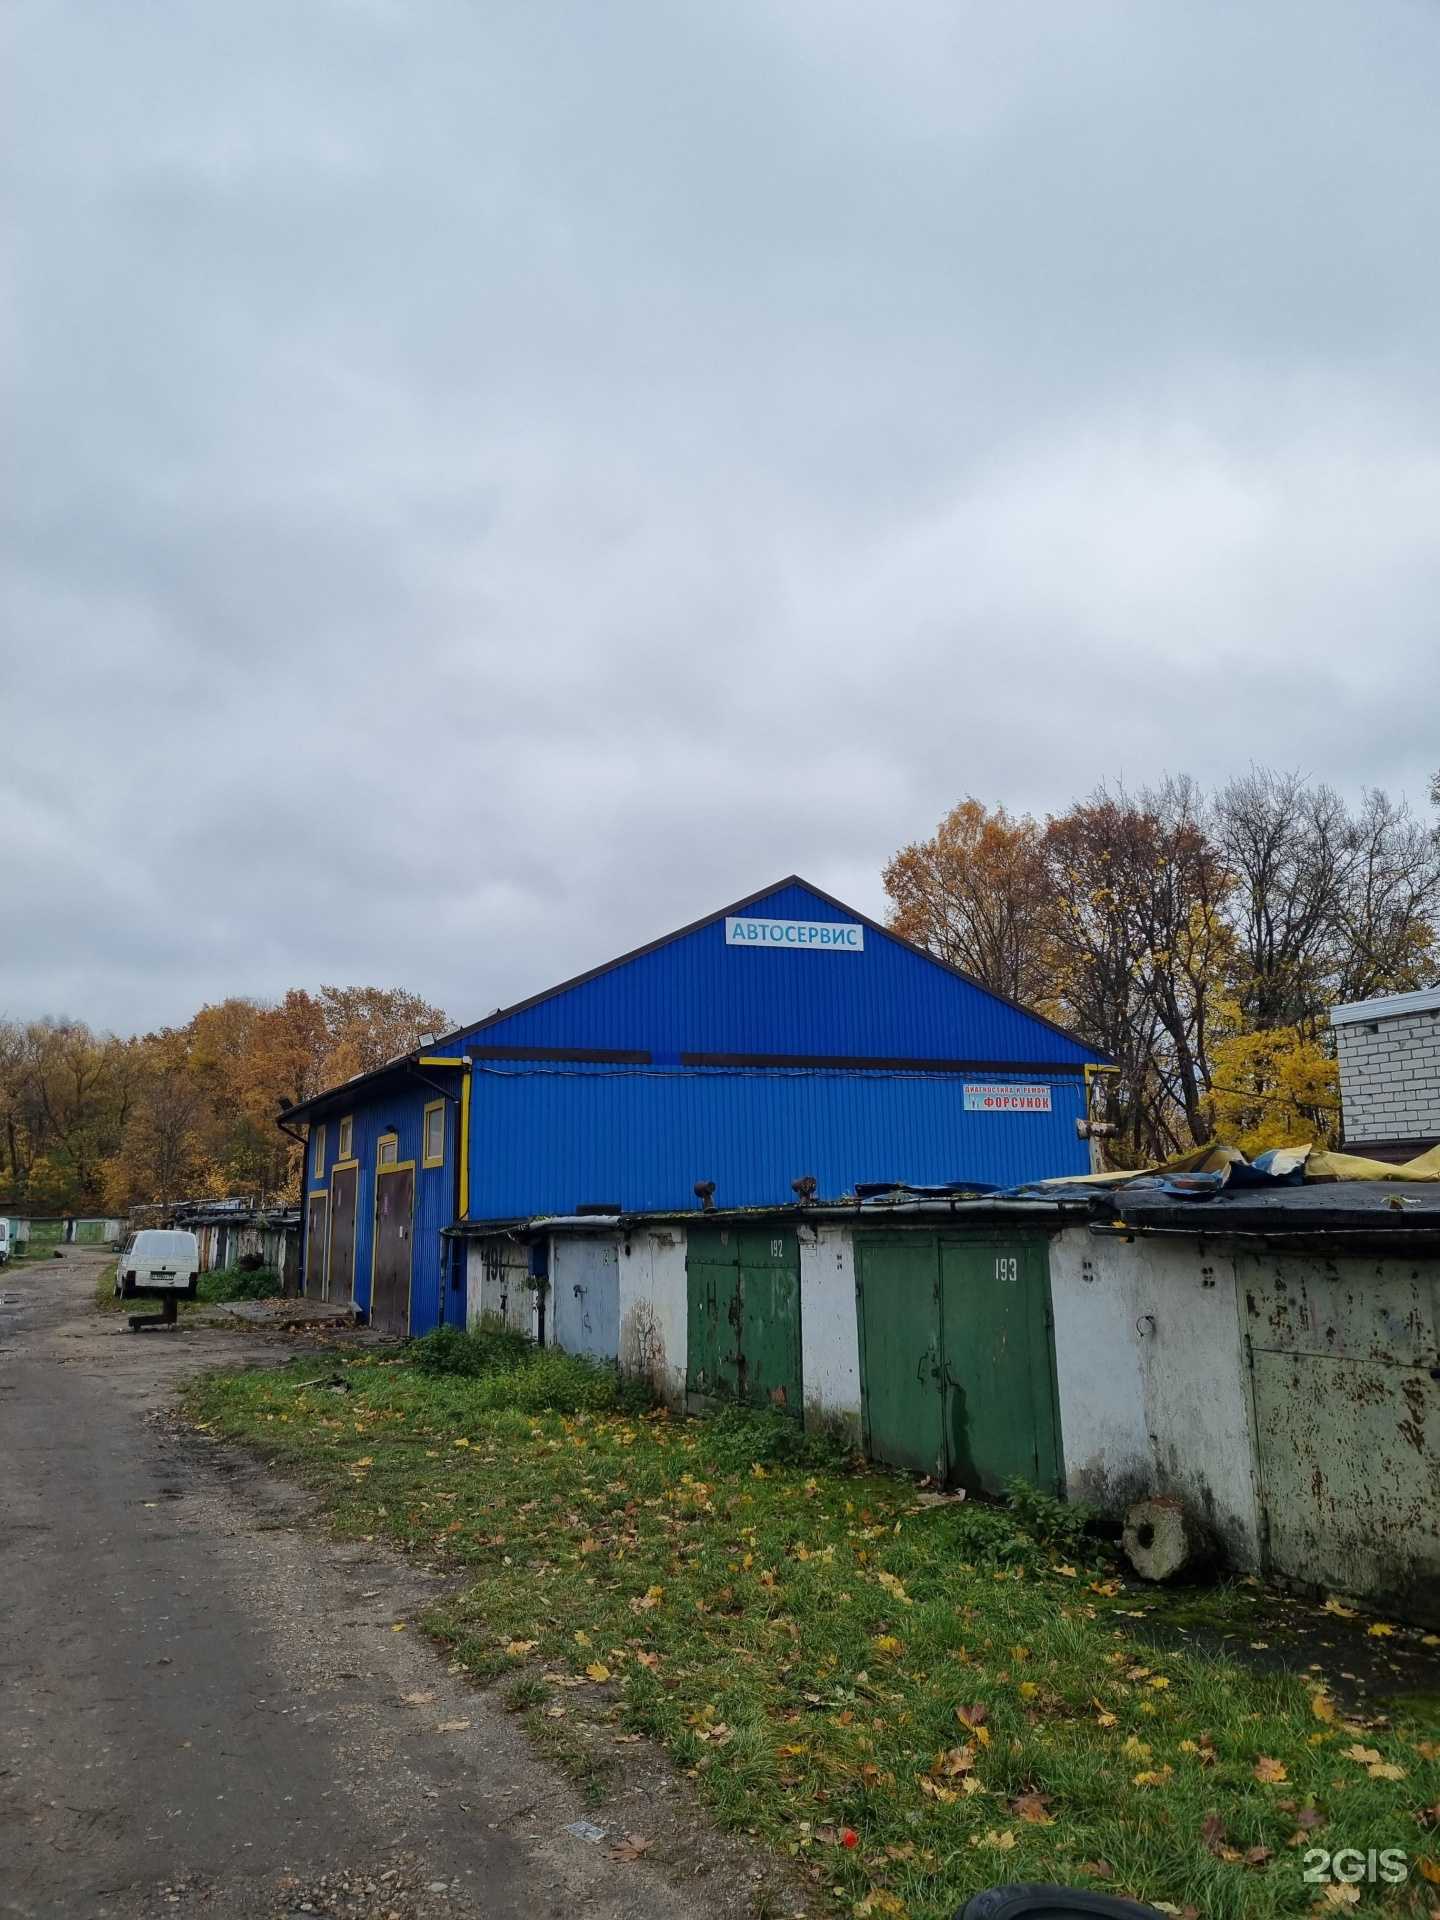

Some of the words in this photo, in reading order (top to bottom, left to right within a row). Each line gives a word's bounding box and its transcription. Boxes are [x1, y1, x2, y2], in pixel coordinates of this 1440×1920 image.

[732, 922, 857, 946] АВТОСЕРВИС
[984, 1096, 1049, 1109] ФОРСУНОК
[770, 1239, 783, 1257] 192
[995, 1258, 1017, 1281] 193
